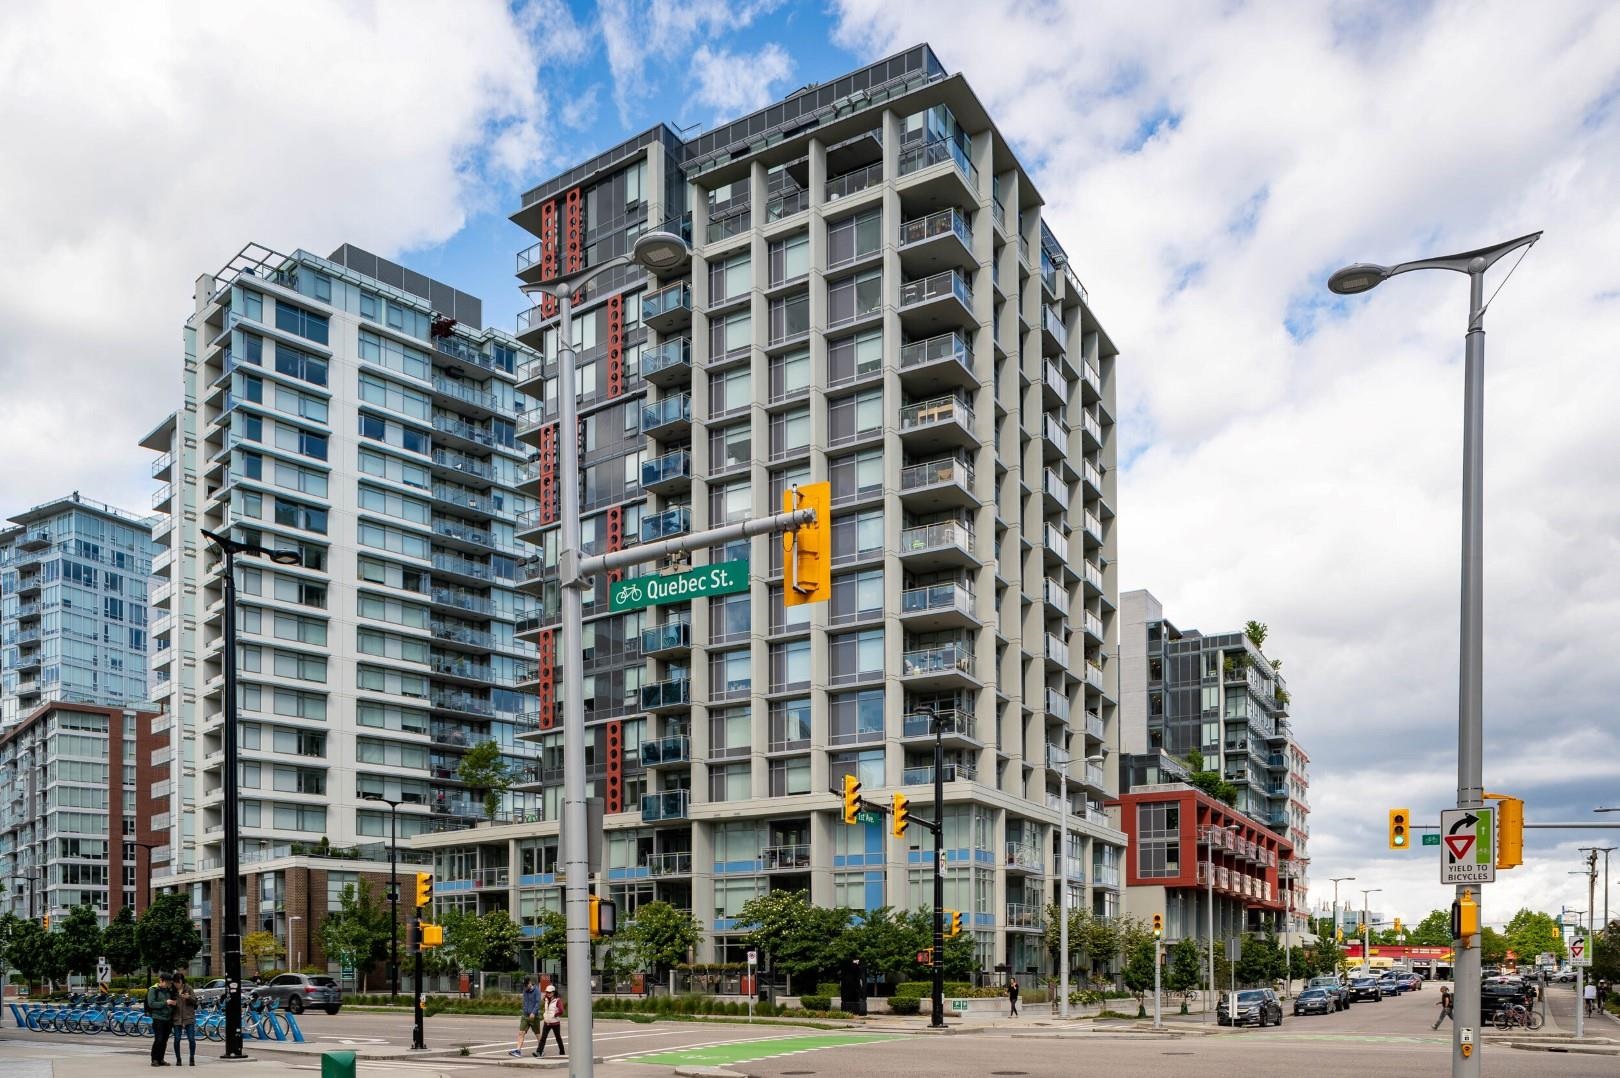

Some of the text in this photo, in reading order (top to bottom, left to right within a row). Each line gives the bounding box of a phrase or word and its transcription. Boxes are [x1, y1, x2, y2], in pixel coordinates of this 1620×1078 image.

[647, 570, 734, 599] Quebec St.
[1448, 873, 1488, 881] BICYCLES
